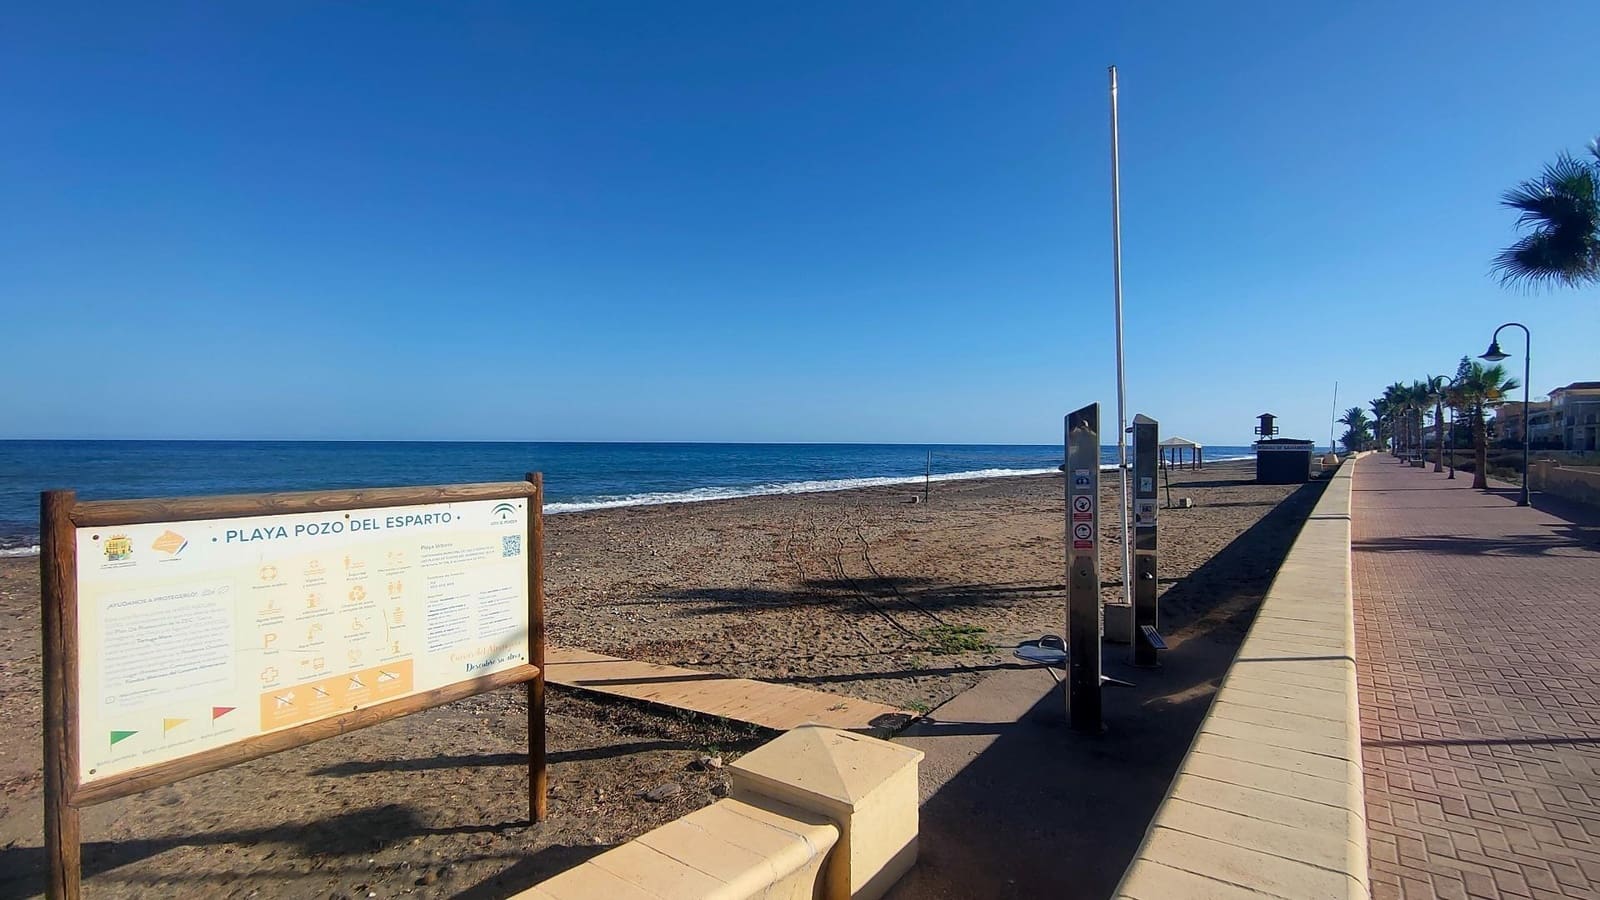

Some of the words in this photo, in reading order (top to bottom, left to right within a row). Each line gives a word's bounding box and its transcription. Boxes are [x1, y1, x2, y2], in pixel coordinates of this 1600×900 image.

[226, 526, 288, 543] PLAYA
[295, 521, 344, 537] POZO
[350, 518, 380, 532] DEL
[386, 512, 452, 529] ESPARTO
